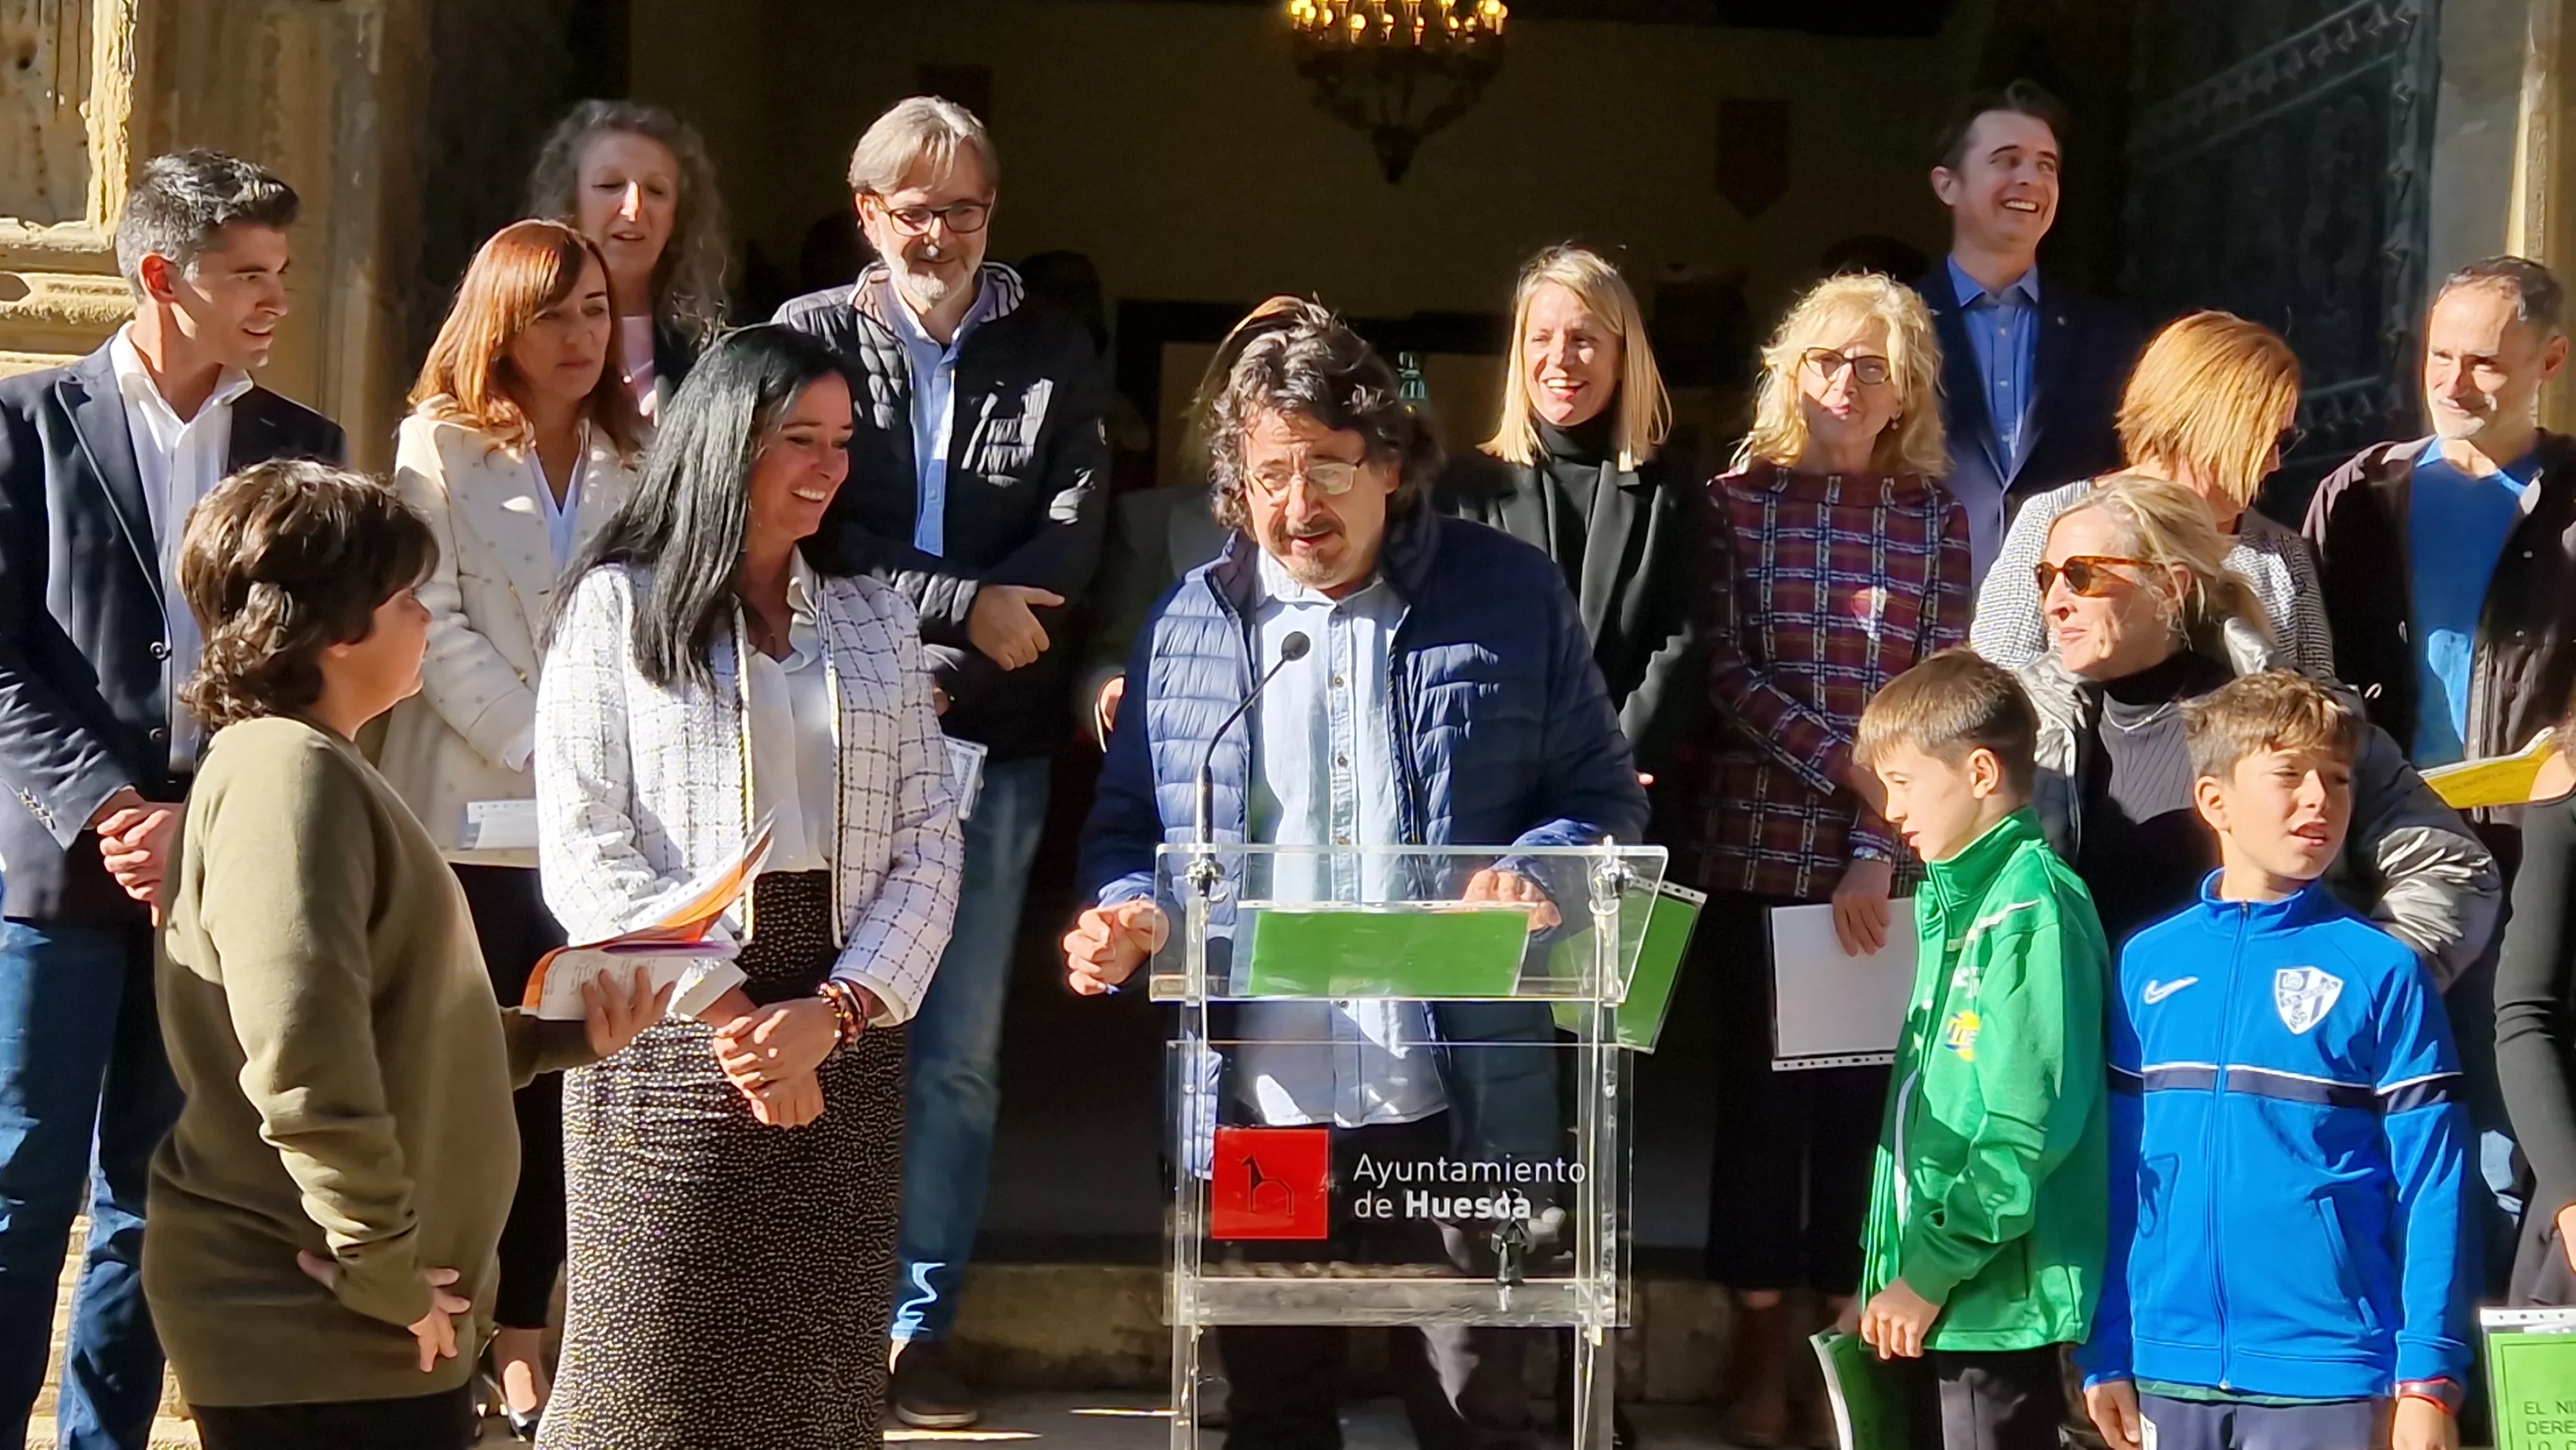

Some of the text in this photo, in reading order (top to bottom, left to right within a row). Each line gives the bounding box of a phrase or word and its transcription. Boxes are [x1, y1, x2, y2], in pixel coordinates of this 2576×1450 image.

[1353, 1153, 1586, 1189] Ayuntamiento
[1354, 1190, 1531, 1219] de Huesca
[2524, 1400, 2546, 1415] EL
